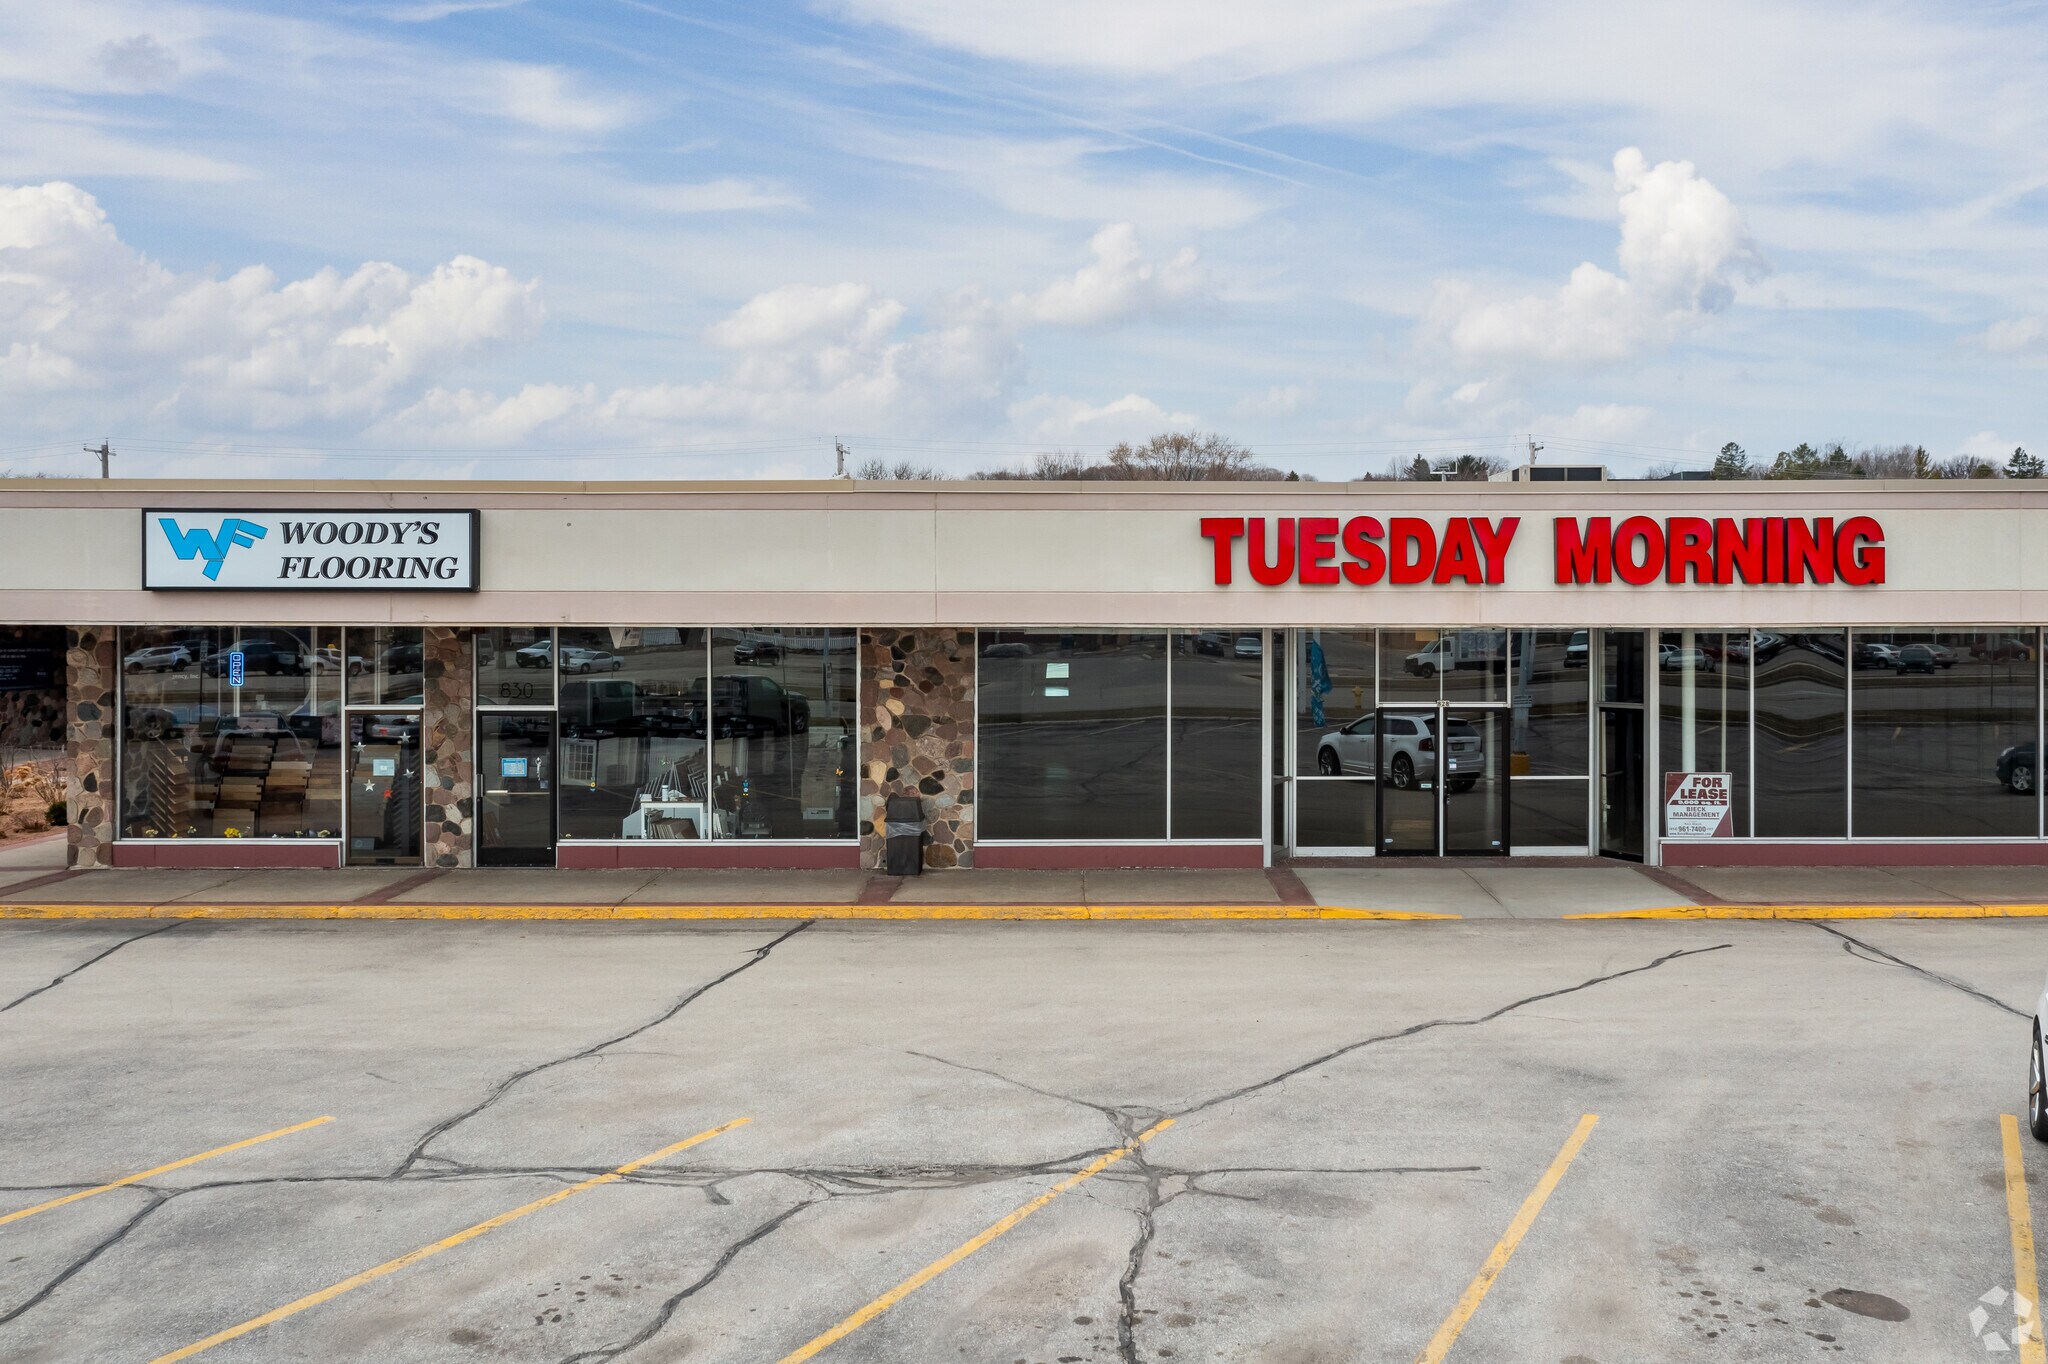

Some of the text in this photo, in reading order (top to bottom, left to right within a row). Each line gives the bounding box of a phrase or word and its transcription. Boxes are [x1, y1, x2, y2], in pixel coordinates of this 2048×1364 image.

[280, 520, 440, 545] WOODY'S
[1200, 516, 1886, 586] TUESDAY MORNING
[277, 556, 459, 580] FLOORING
[232, 654, 241, 684] OPEN
[501, 682, 534, 698] 830
[1681, 789, 1727, 799] LEASE
[1693, 777, 1722, 788] FOR
